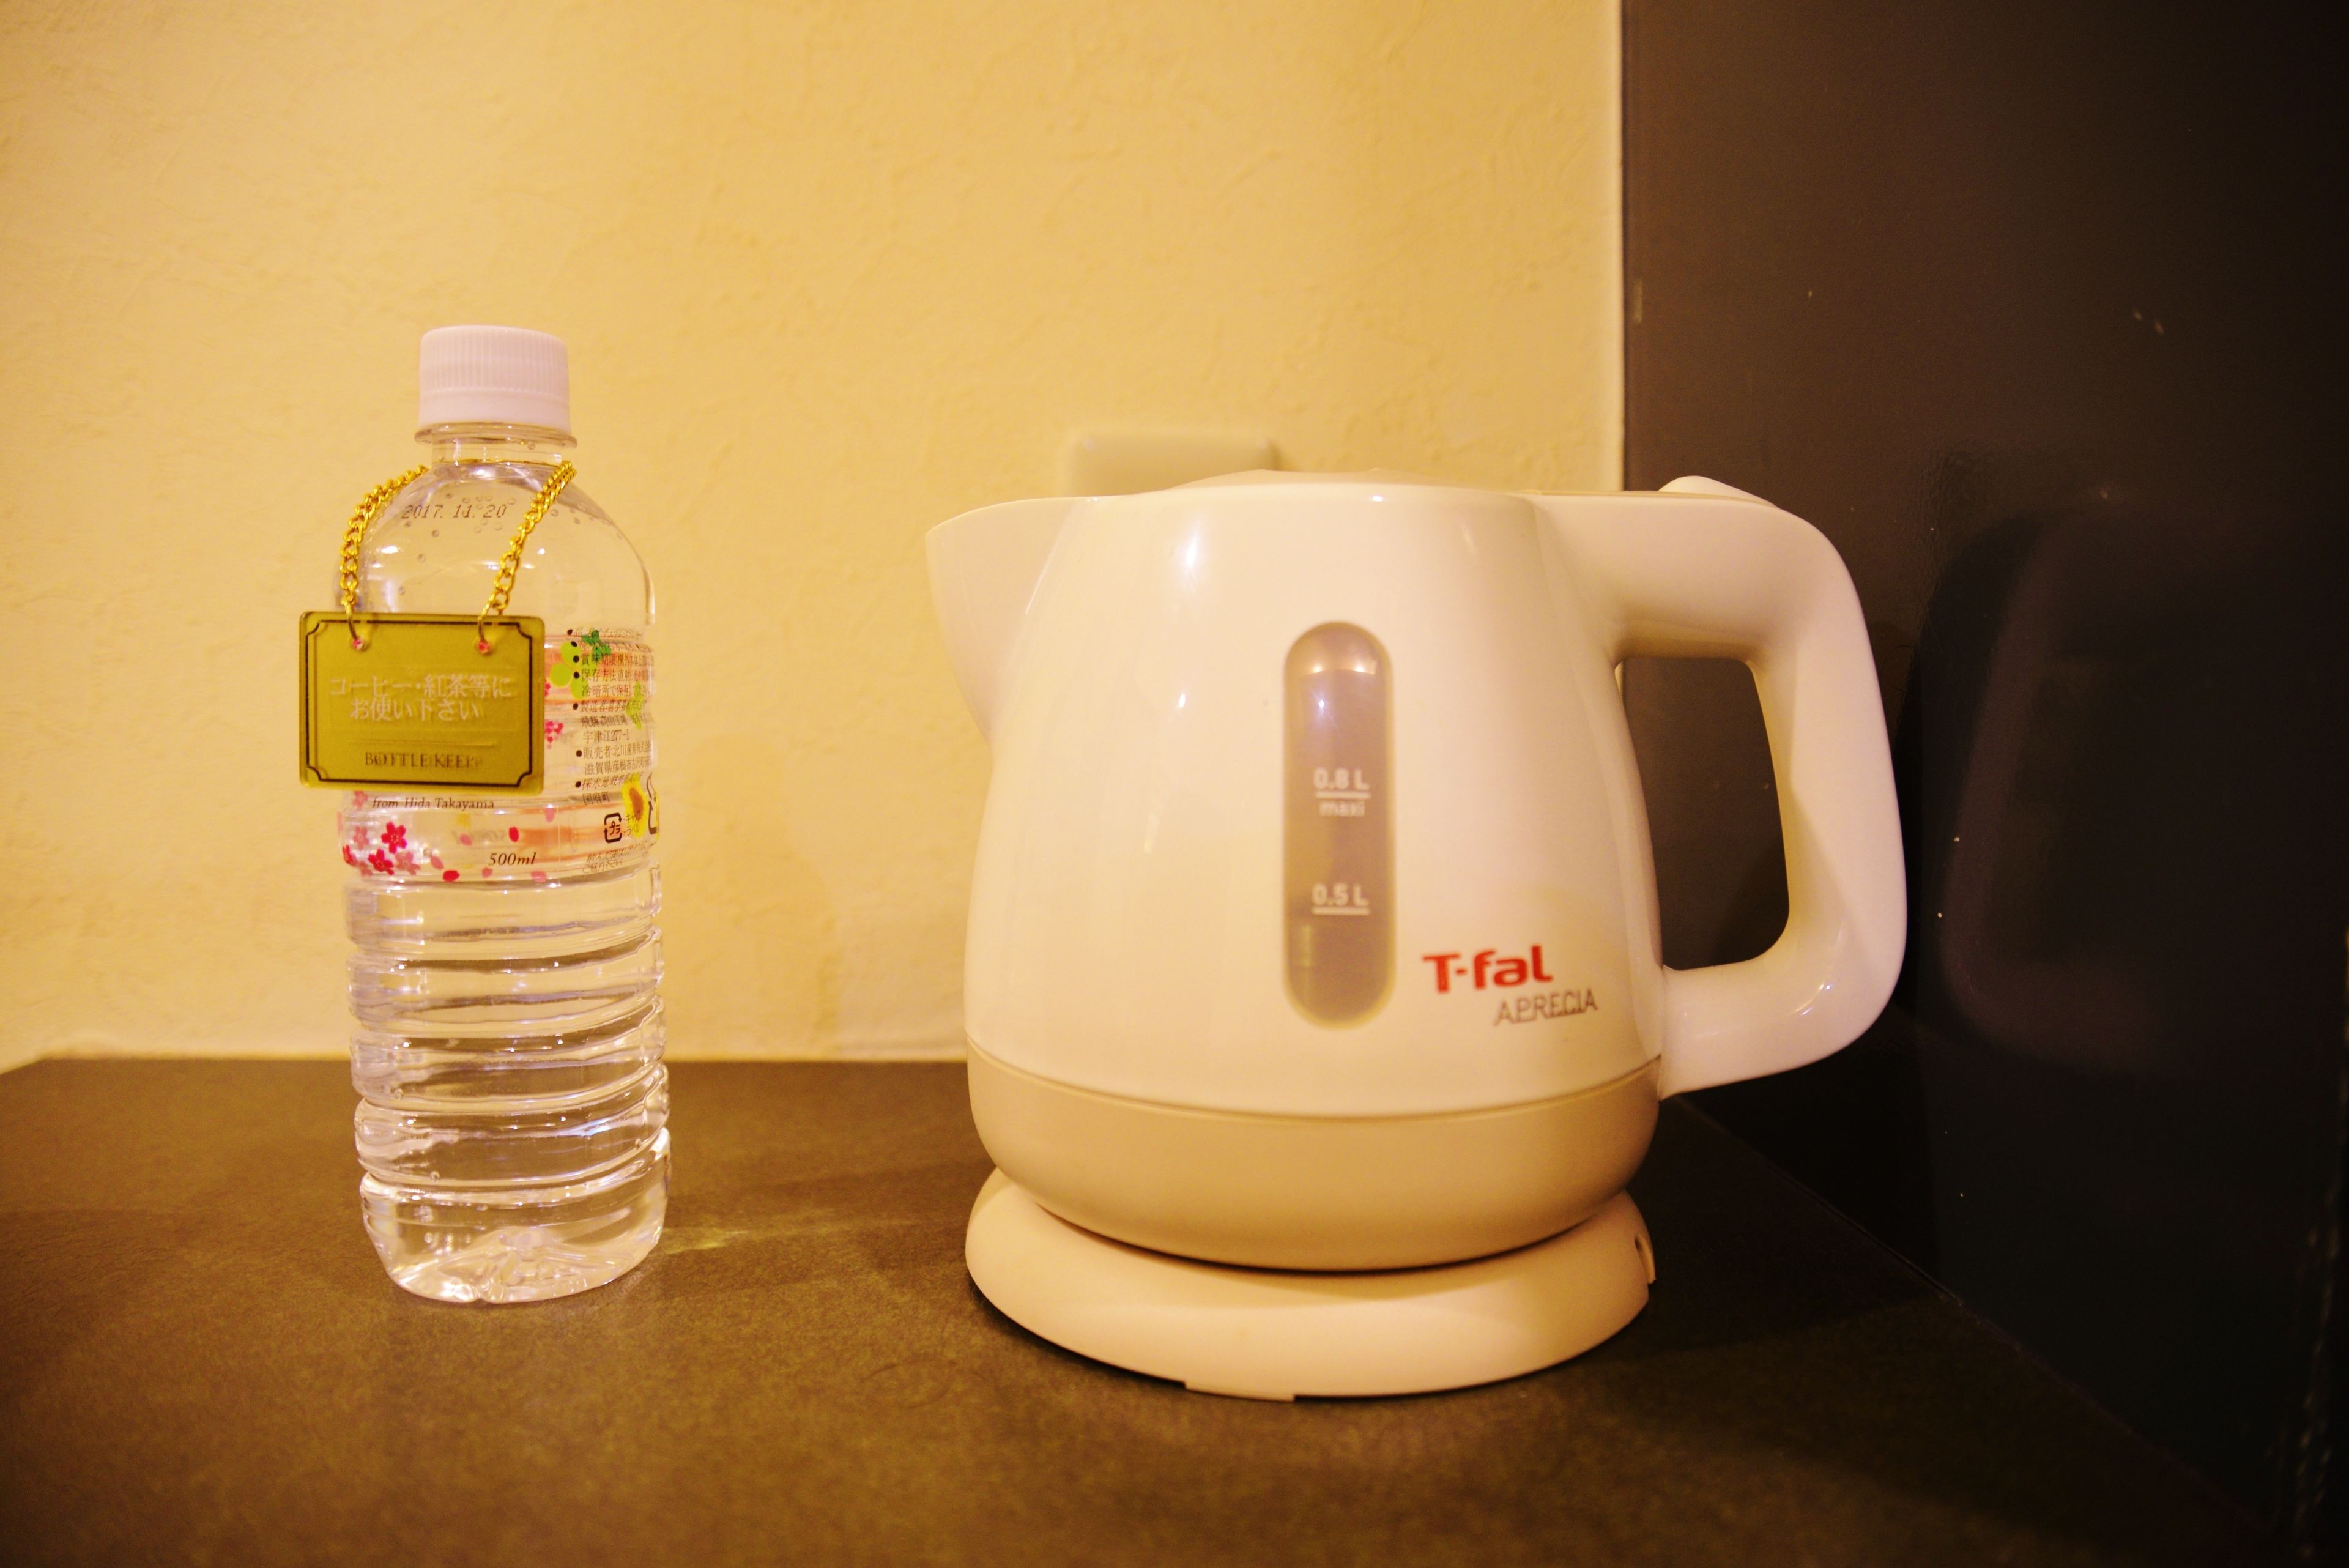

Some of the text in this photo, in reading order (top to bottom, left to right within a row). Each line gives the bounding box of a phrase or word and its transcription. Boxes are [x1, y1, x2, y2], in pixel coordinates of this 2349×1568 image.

[349, 697, 480, 722] お使い下さい
[365, 752, 428, 768] BOTTLE
[1353, 767, 1370, 790] L
[373, 796, 494, 812] from Hida Takayama
[609, 820, 621, 836] プラ
[489, 852, 536, 866] 500ml
[1311, 883, 1369, 907] 0.5 L
[1422, 944, 1554, 995] T-fal
[1493, 986, 1599, 1027] APRECIA
